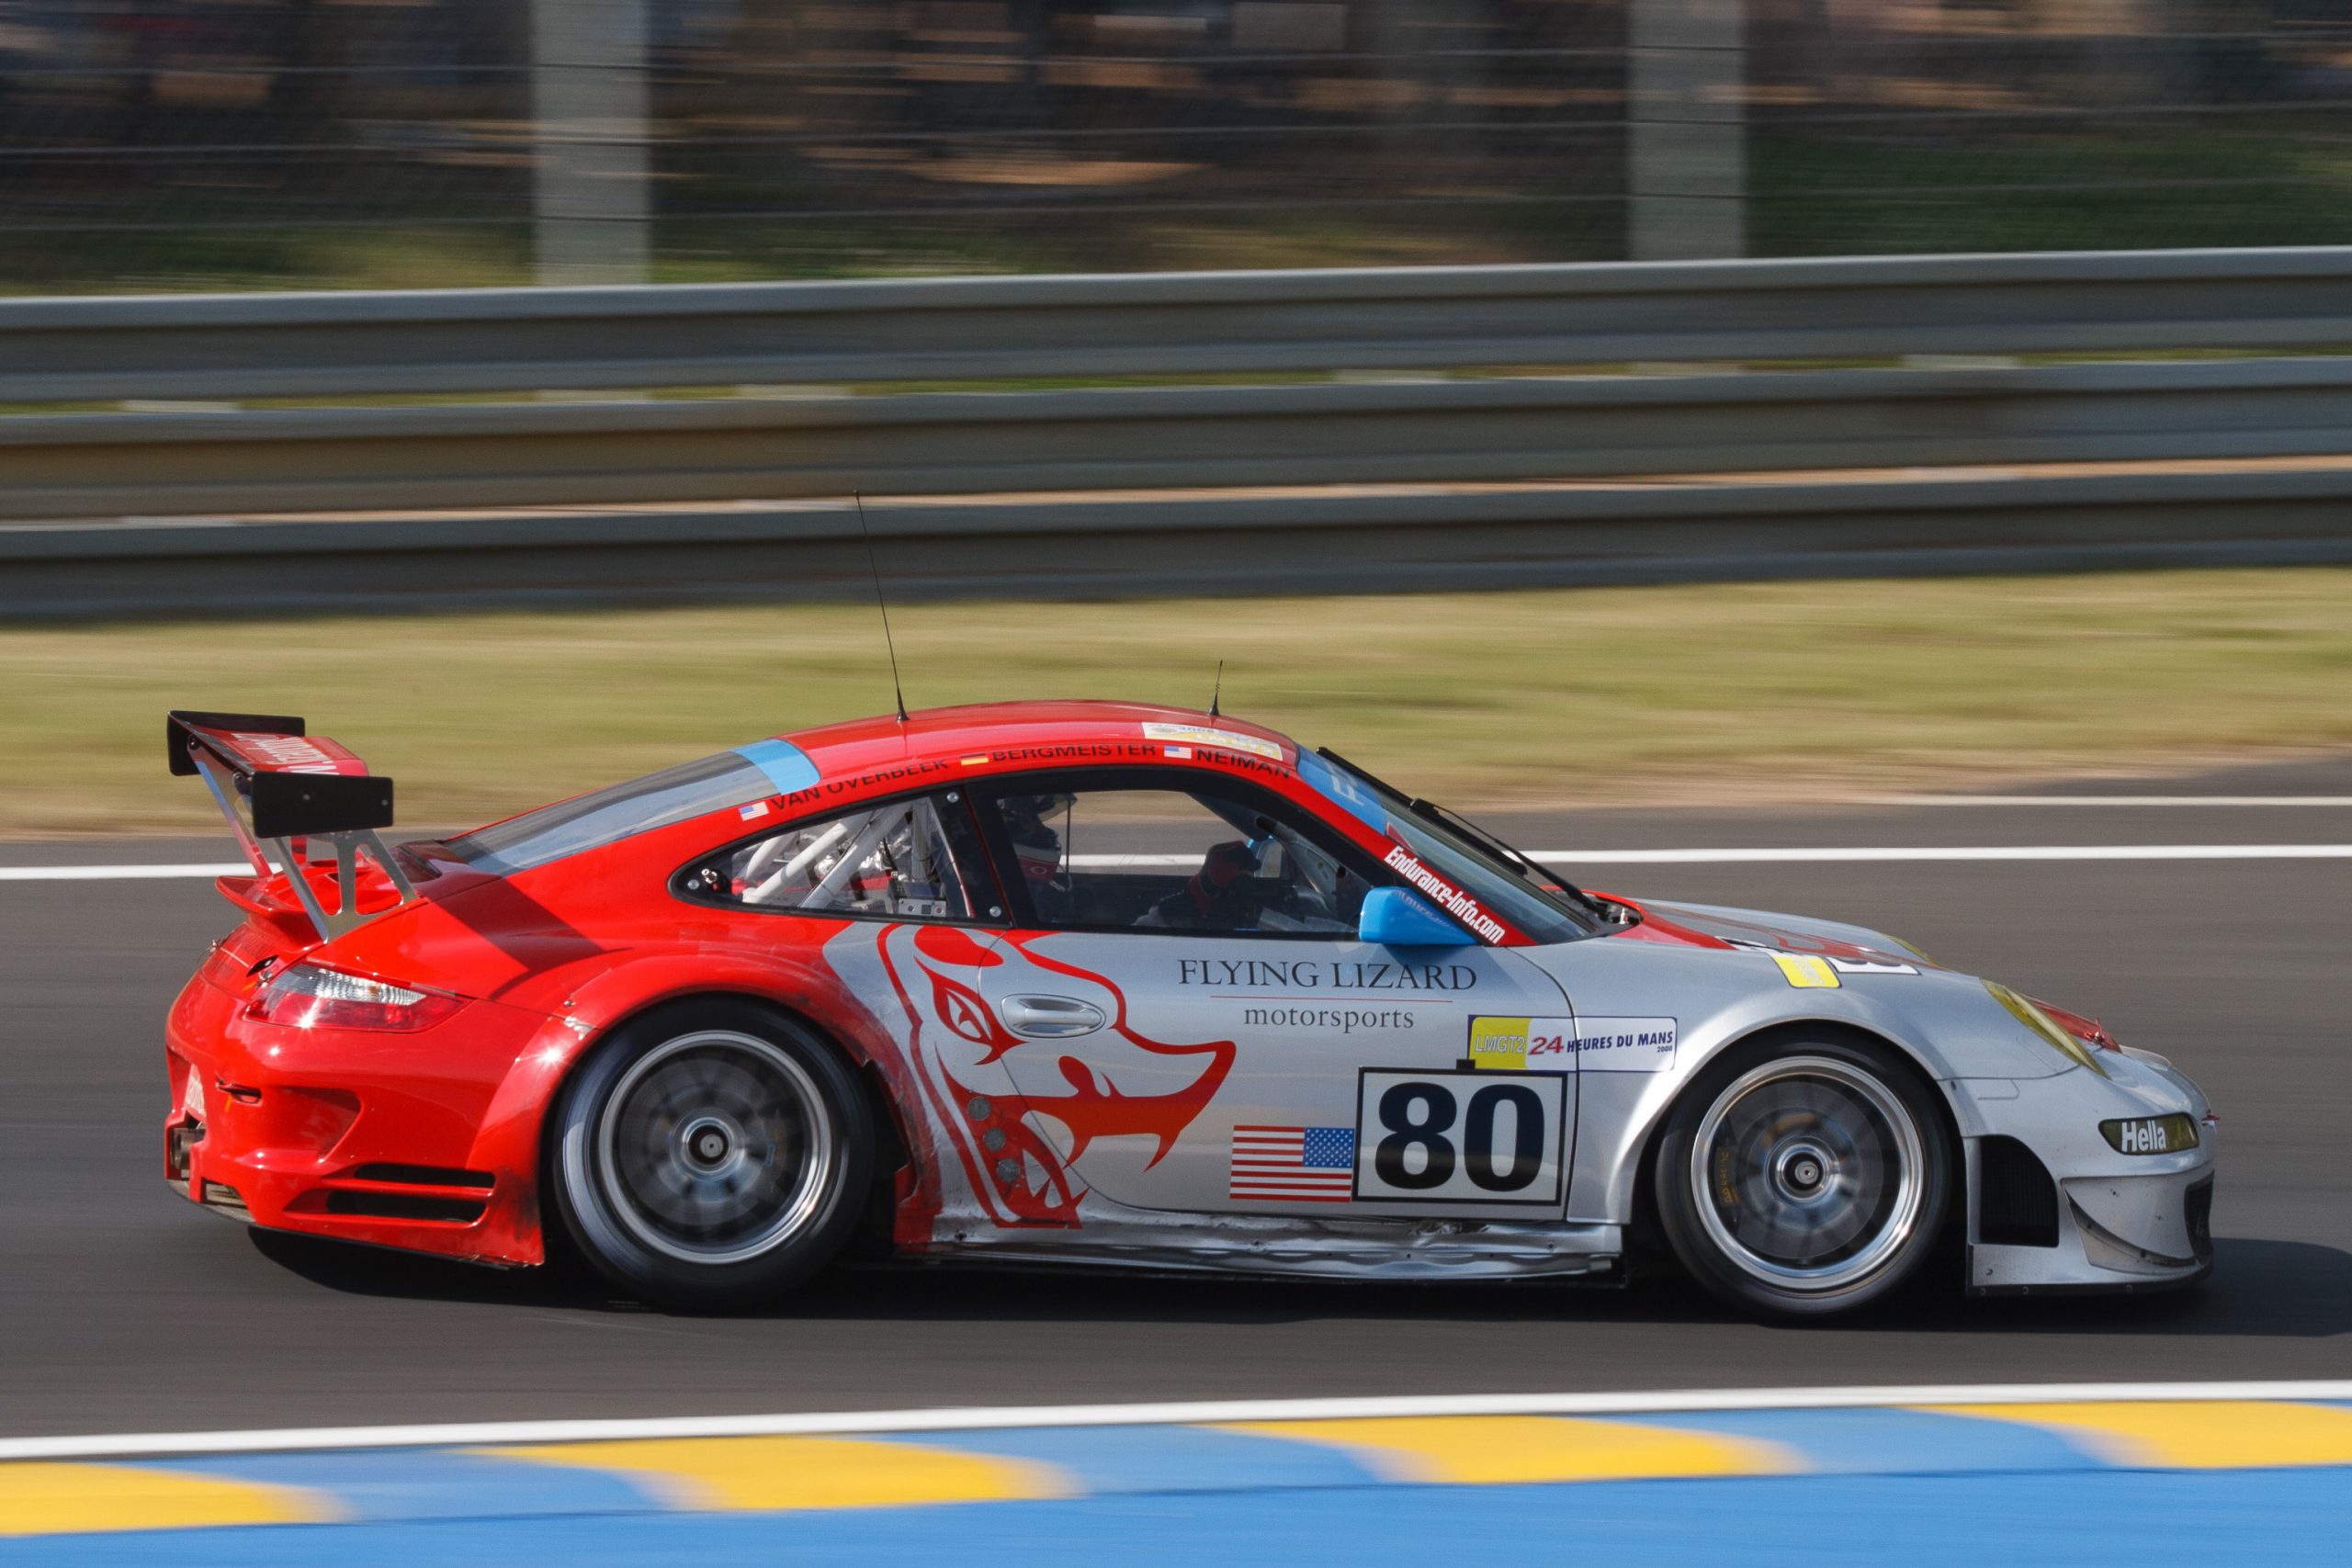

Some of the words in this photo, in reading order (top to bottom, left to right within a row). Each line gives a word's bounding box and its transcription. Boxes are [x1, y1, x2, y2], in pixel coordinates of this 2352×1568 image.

[992, 744, 1156, 761] BERGMEISTER
[1197, 749, 1290, 778] NEIMAN
[771, 787, 821, 810] VAN
[1384, 845, 1506, 944] Endurance-Info.com
[1178, 959, 1319, 987] FLYING
[1332, 963, 1476, 990] LIZARD
[1244, 1008, 1414, 1033] motorsports
[1475, 1034, 1526, 1054] LMGT2
[1528, 1036, 1564, 1055] 24
[1566, 1036, 1612, 1053] HEURES
[1617, 1034, 1634, 1047] DU
[1637, 1031, 1673, 1045] MANS
[1374, 1082, 1544, 1192] 80
[2121, 1120, 2166, 1152] Hella
